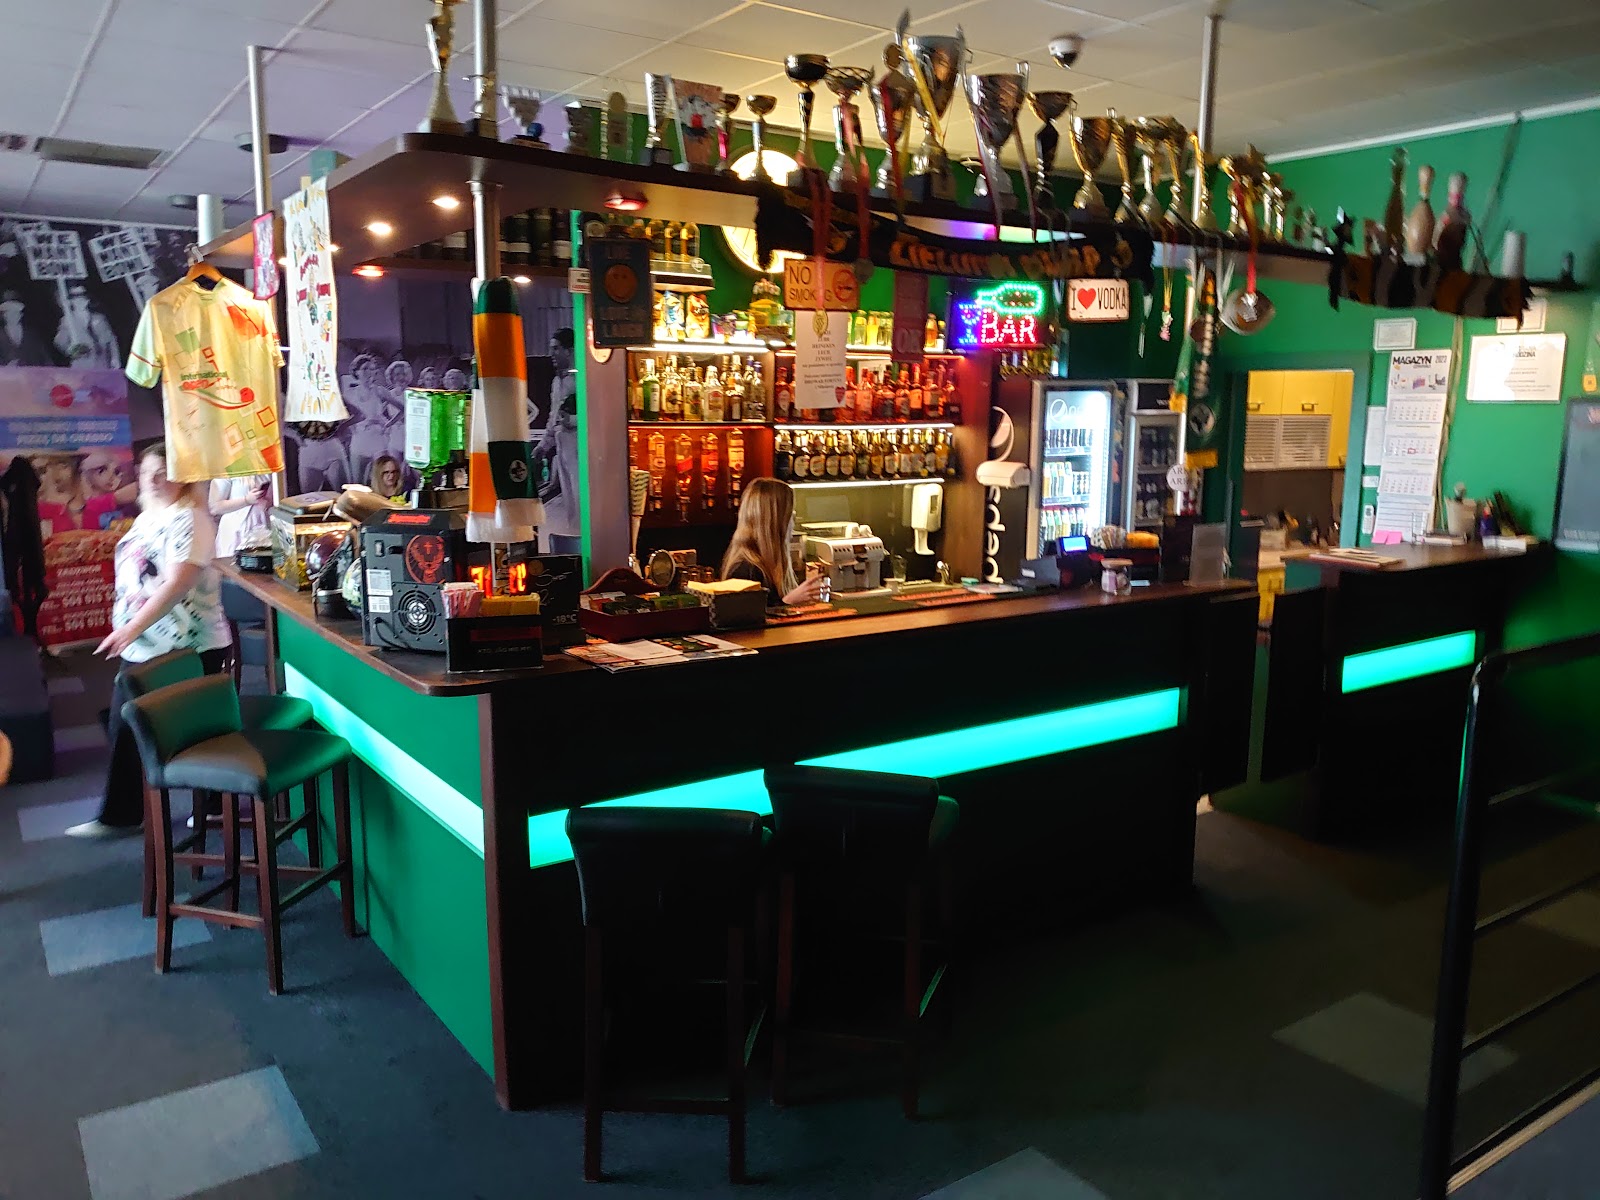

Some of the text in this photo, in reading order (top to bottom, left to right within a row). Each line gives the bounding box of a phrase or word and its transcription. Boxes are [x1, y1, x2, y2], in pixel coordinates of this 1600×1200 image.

[789, 265, 812, 285] NO
[789, 288, 833, 302] SMOKG
[1071, 287, 1128, 311] I VODKA
[980, 307, 1037, 344] BAR
[1393, 355, 1433, 365] MAGAZYN
